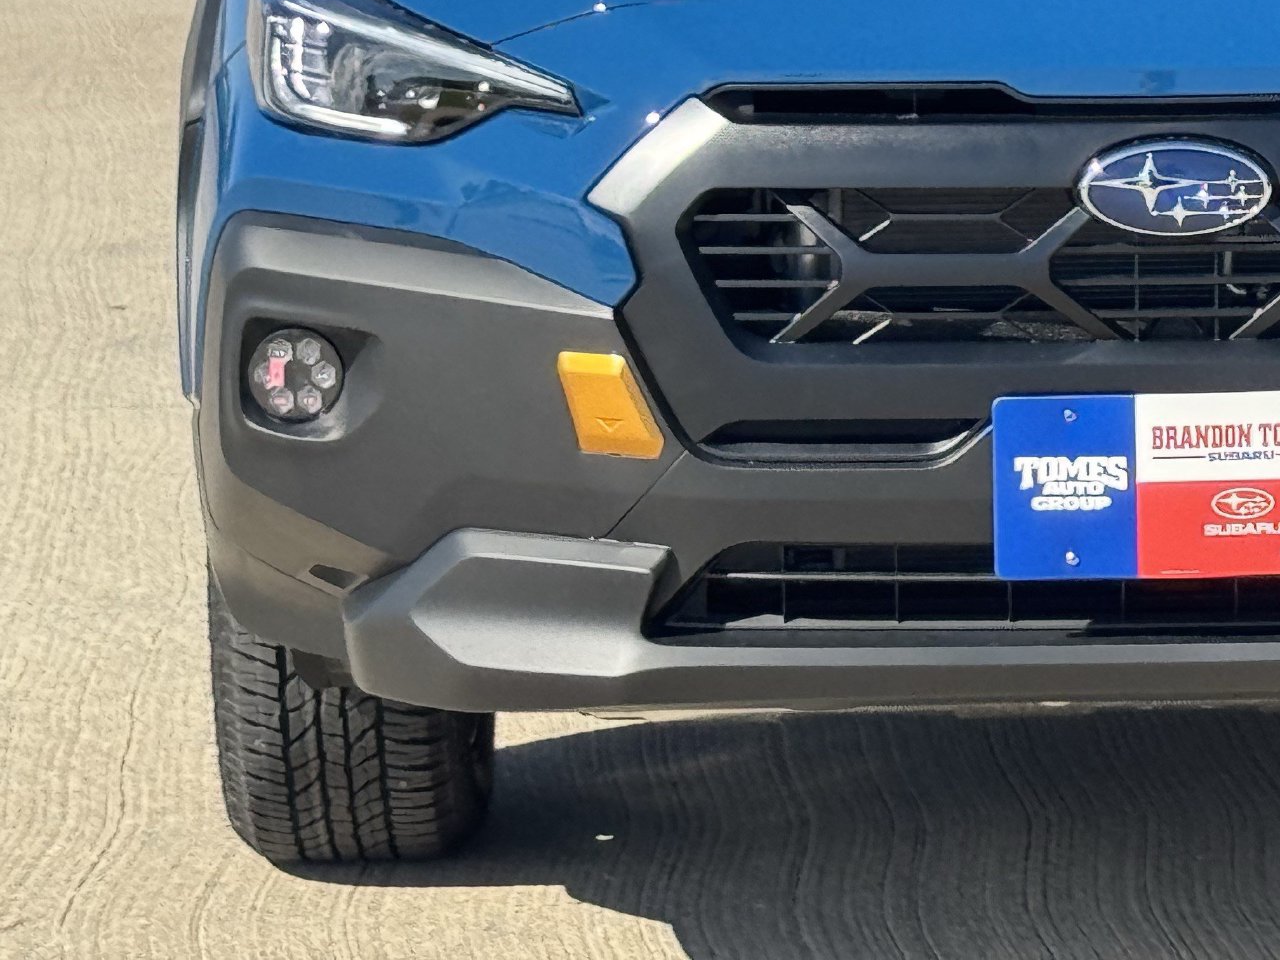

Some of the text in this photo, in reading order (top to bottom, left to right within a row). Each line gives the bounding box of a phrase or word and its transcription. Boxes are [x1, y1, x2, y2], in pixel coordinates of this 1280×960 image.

[1152, 424, 1252, 449] BRANDON
[1207, 450, 1275, 462] SUBARU
[1013, 456, 1128, 490] TOMES
[1042, 480, 1106, 496] AUTO
[1030, 495, 1113, 511] GROUP
